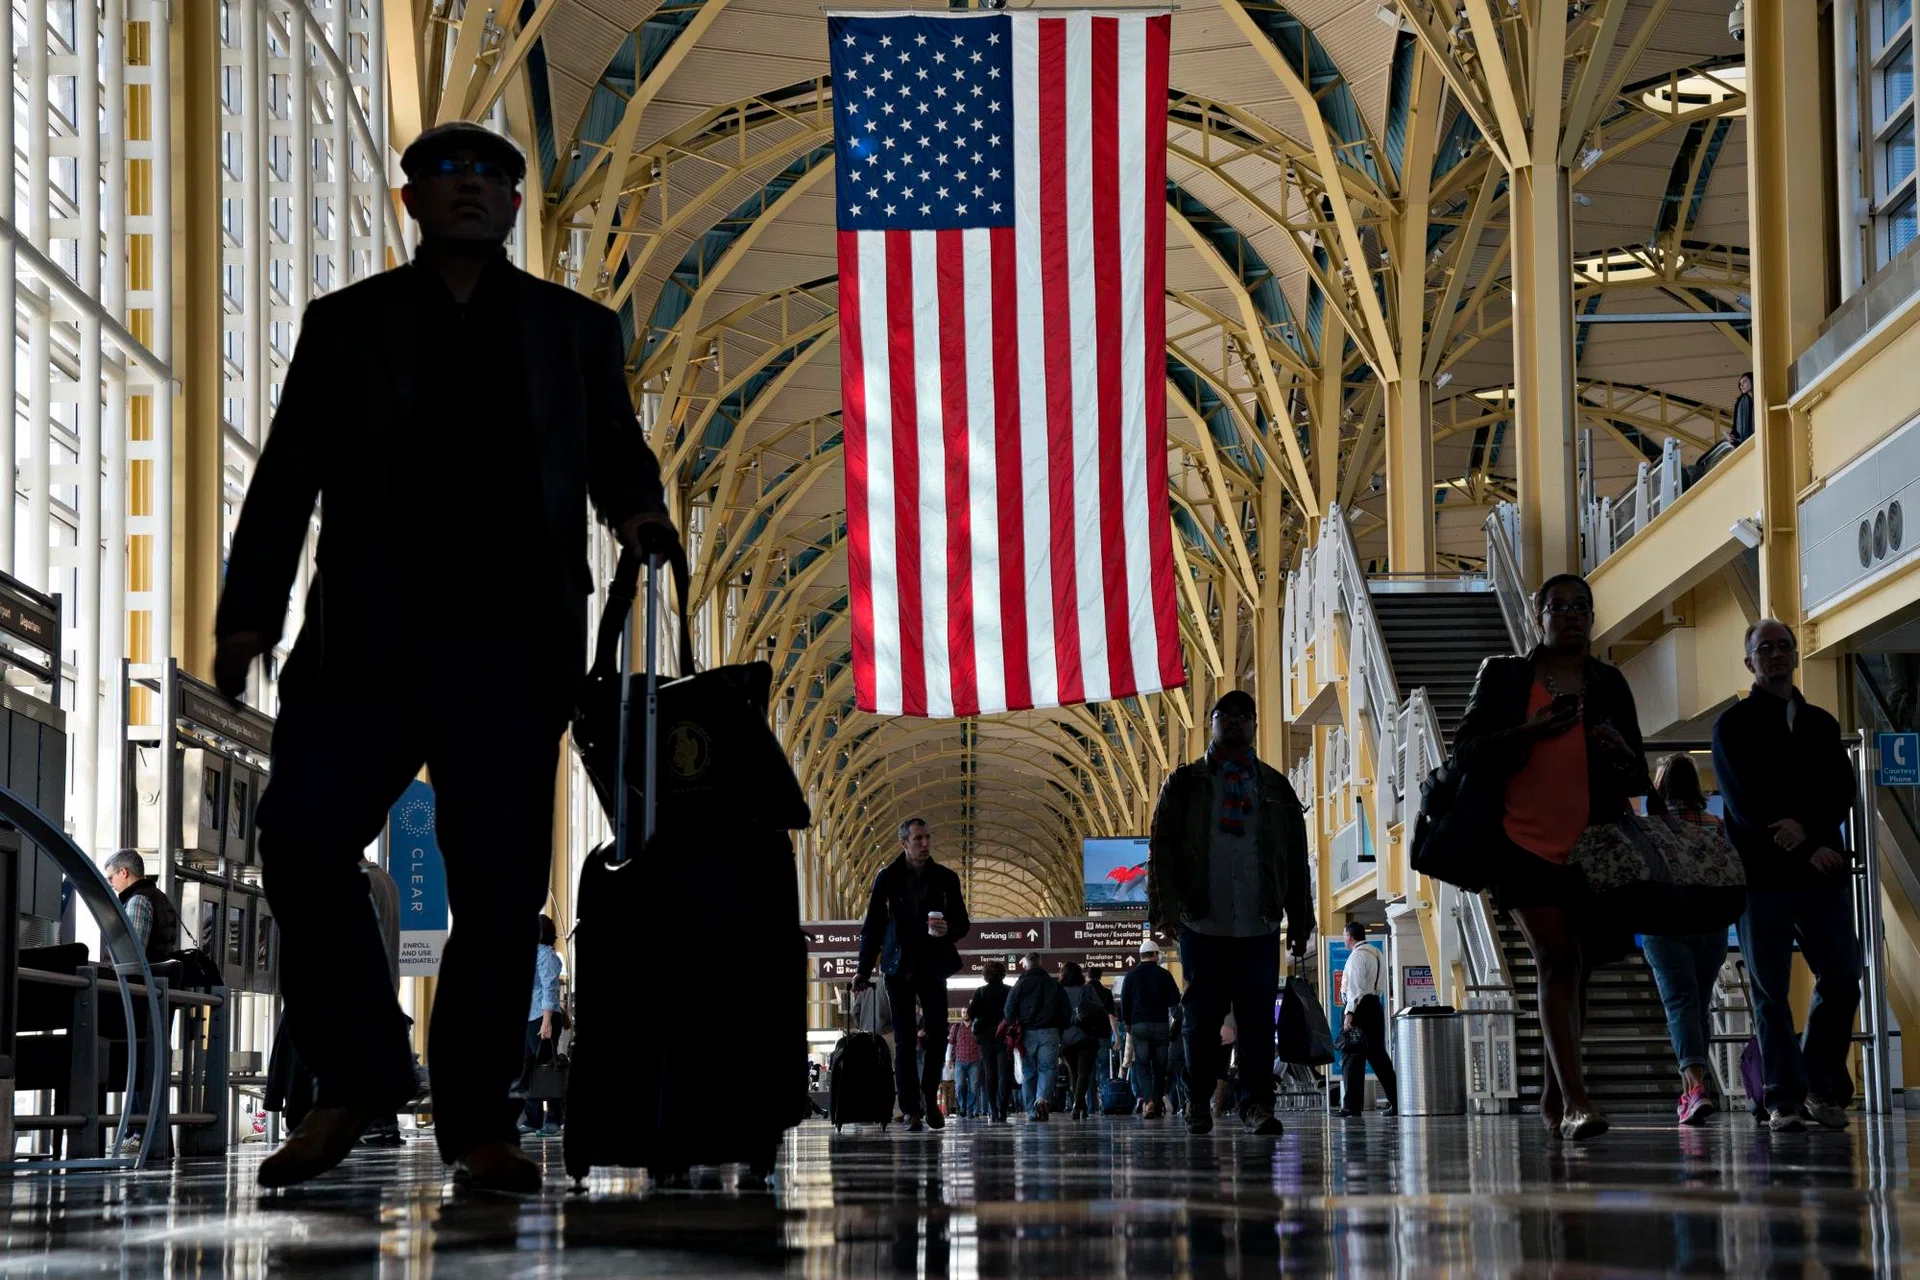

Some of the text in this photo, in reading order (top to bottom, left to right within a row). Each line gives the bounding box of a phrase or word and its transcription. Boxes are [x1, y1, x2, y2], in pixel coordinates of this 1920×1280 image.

[1883, 767, 1917, 775] Courtesy
[411, 848, 424, 911] CLEAR
[1095, 922, 1142, 931] Metro/Parking
[828, 935, 851, 943] Gates
[980, 932, 1007, 941] Parking
